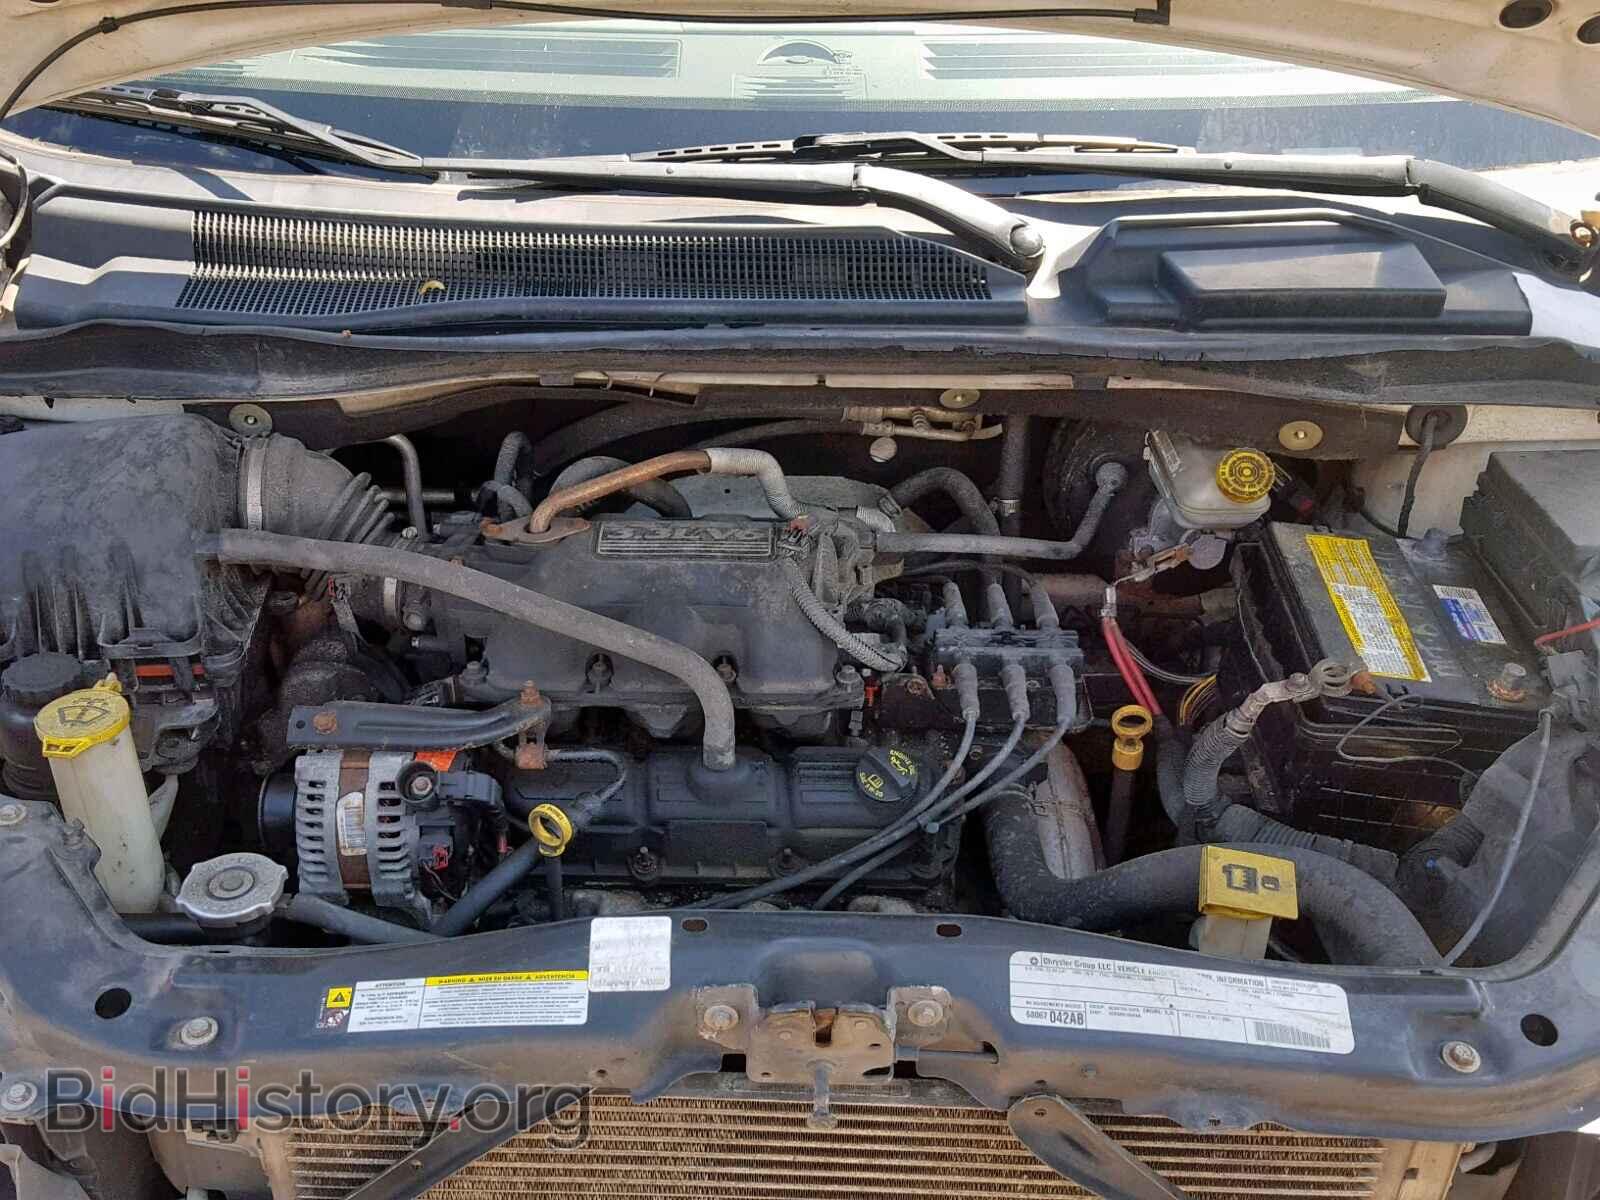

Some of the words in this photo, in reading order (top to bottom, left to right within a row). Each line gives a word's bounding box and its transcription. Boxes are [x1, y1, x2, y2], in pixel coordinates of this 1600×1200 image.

[704, 527, 766, 540] V6
[1043, 957, 1073, 968] Chrysler
[1073, 959, 1096, 970] Group
[1097, 962, 1112, 971] LLC
[1116, 965, 1145, 976] VEHICLE
[1049, 1010, 1084, 1026] 042AB
